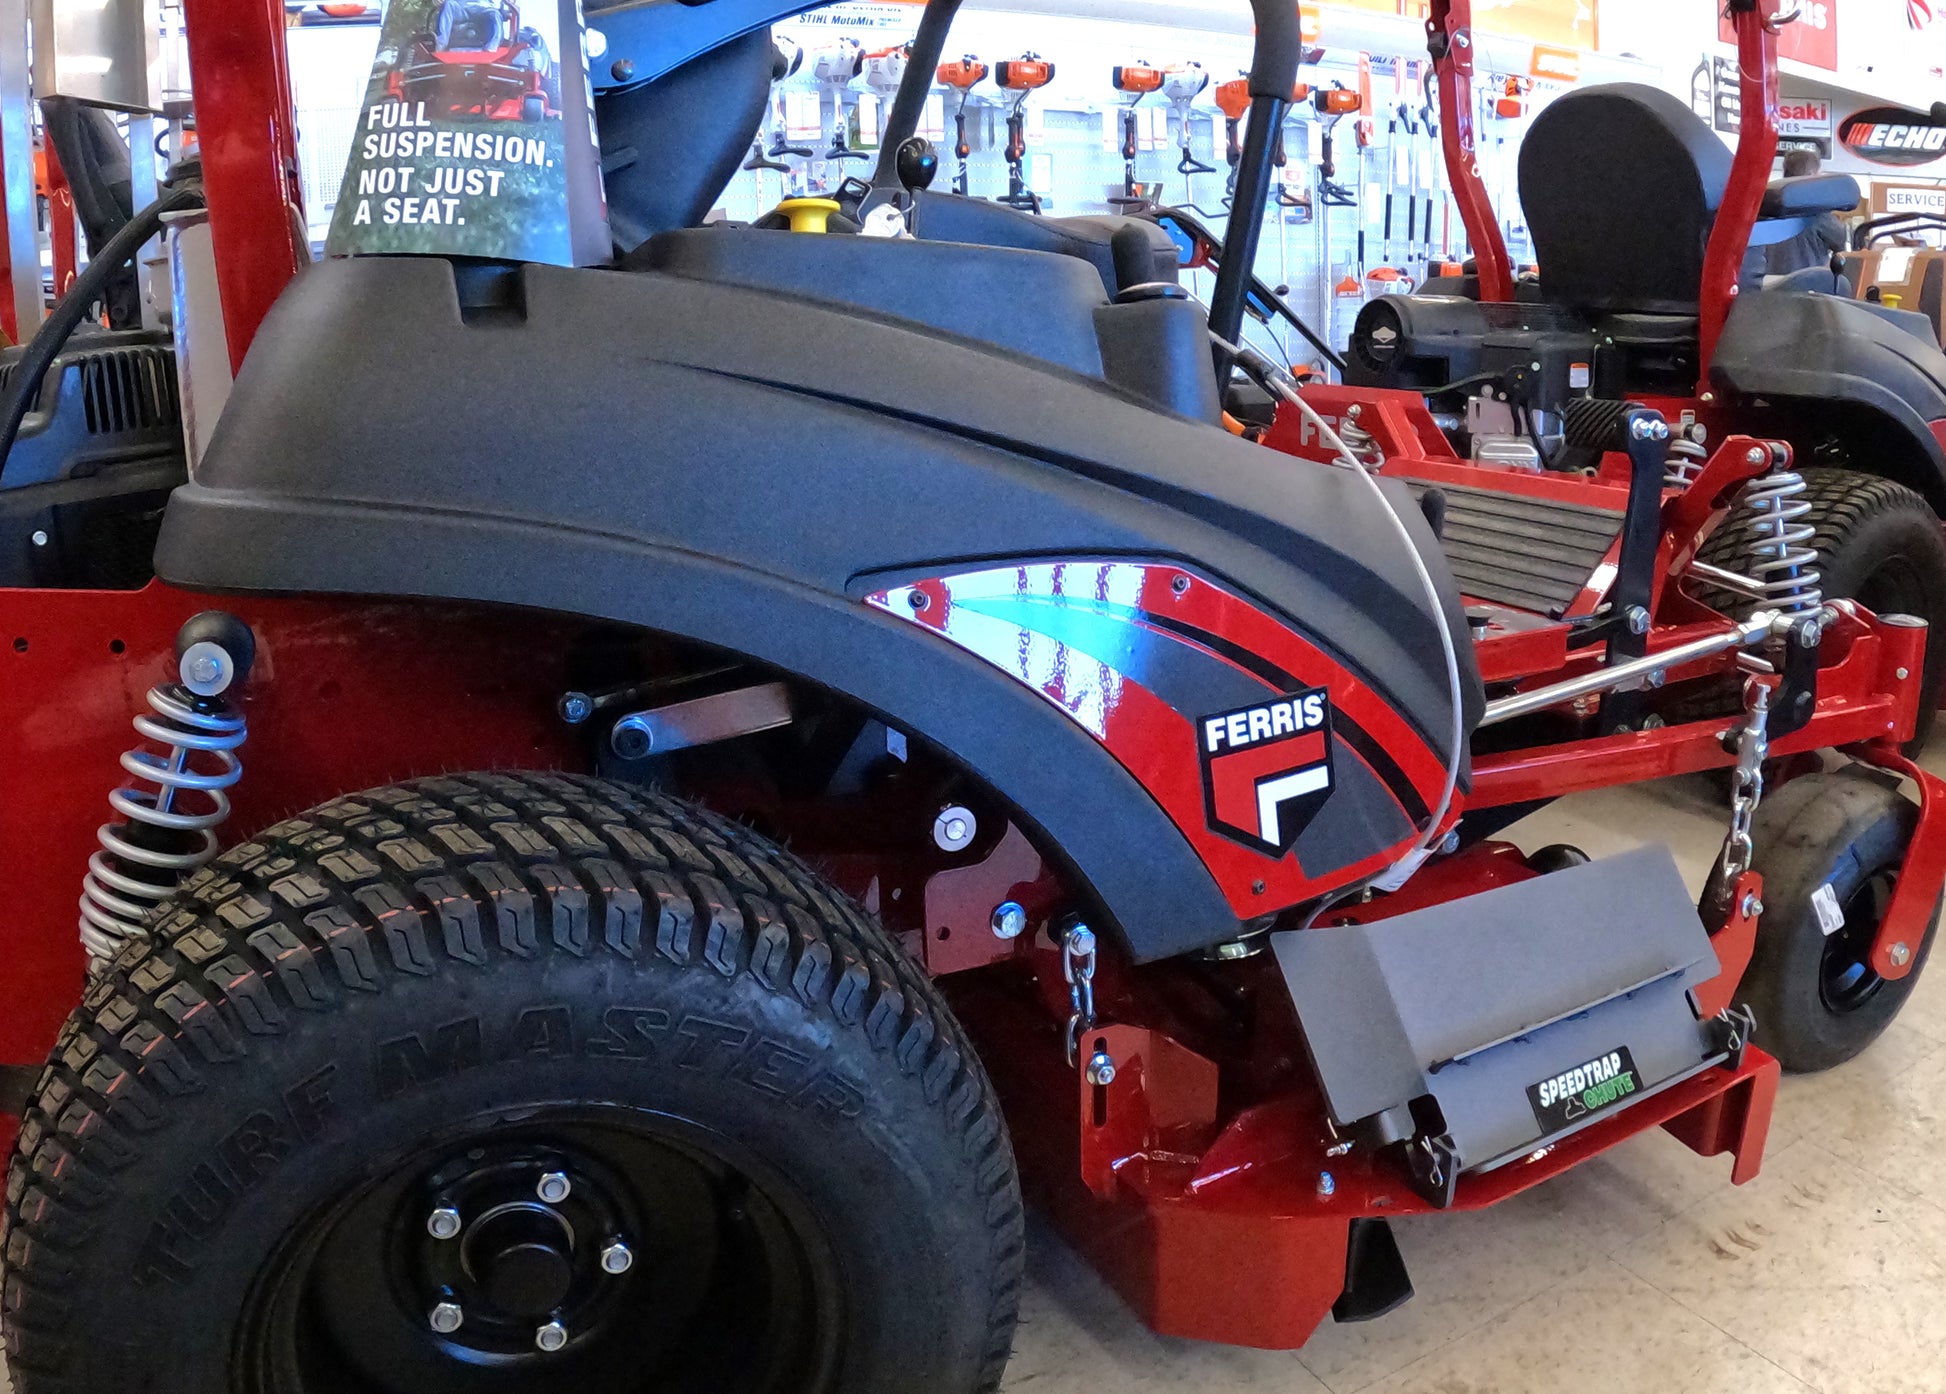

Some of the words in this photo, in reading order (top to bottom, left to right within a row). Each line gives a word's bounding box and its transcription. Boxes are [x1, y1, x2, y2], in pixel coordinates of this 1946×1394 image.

[799, 13, 828, 25] STIHL
[831, 15, 875, 26] MotoMix
[366, 101, 431, 130] FULL
[1779, 103, 1827, 121] saki
[363, 131, 554, 168] SUSPENSION.
[1867, 123, 1946, 150] ECHO
[358, 167, 415, 195] NOT
[424, 168, 505, 197] JUST
[353, 199, 372, 226] A
[382, 198, 466, 226] SEAT.
[1888, 193, 1945, 207] SERVICE
[1205, 694, 1324, 752] FERRIS
[1538, 1051, 1622, 1108] SPEEDTRAP
[1583, 1072, 1636, 1110] CHUTE
[132, 1061, 338, 1287] TURF
[377, 1003, 867, 1119] MASTER
